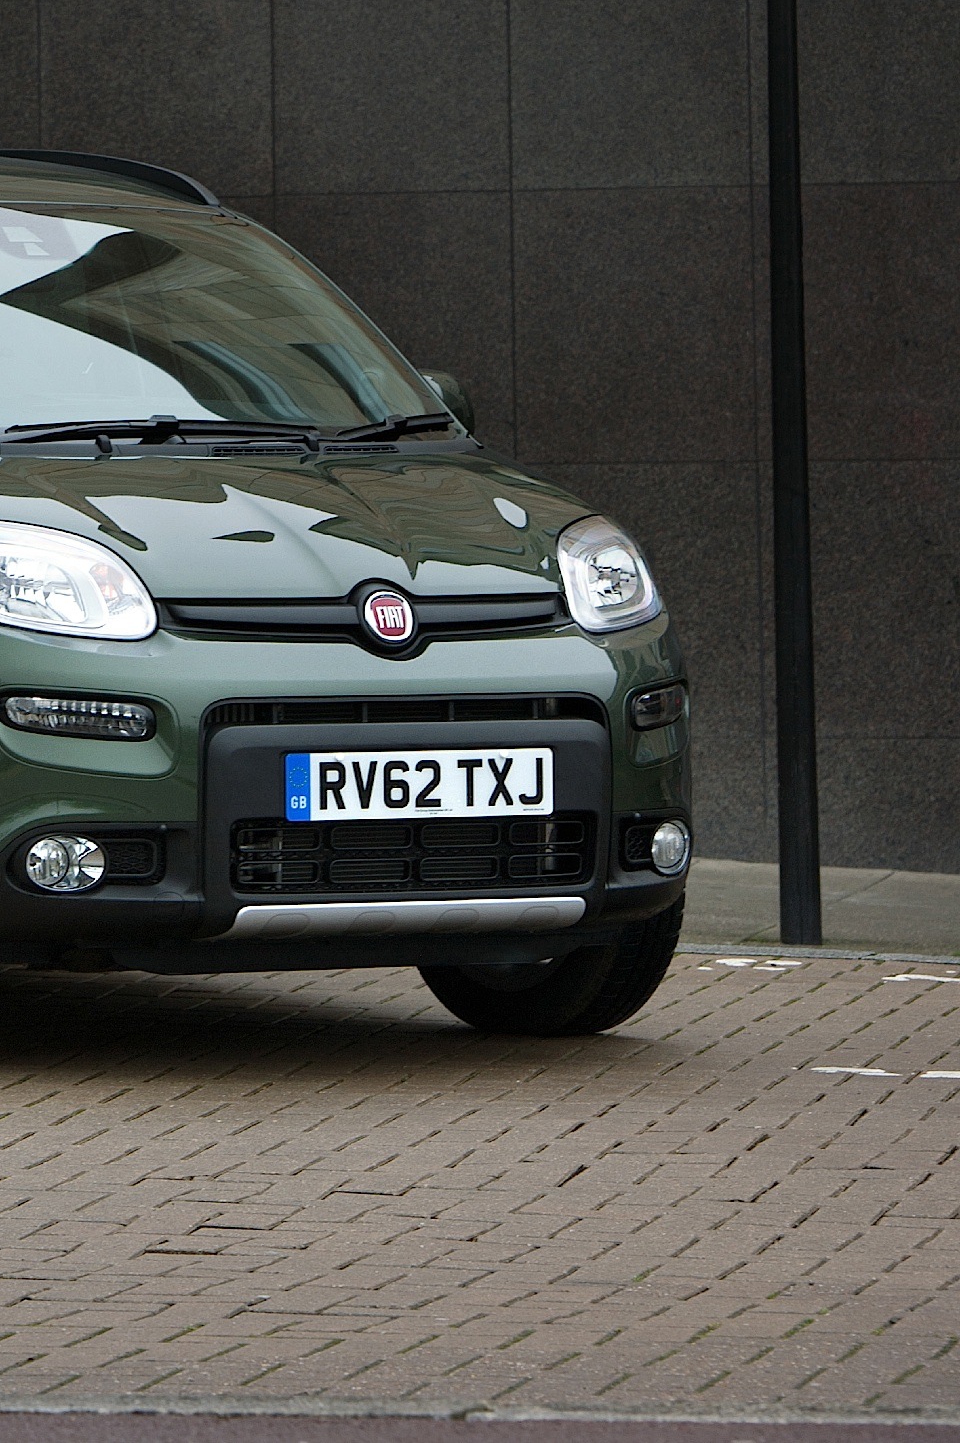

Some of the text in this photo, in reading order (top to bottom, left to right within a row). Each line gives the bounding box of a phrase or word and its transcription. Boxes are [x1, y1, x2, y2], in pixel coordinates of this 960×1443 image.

[375, 605, 405, 629] FIAT
[319, 757, 544, 811] RV62 TXJ
[290, 795, 307, 809] GB
